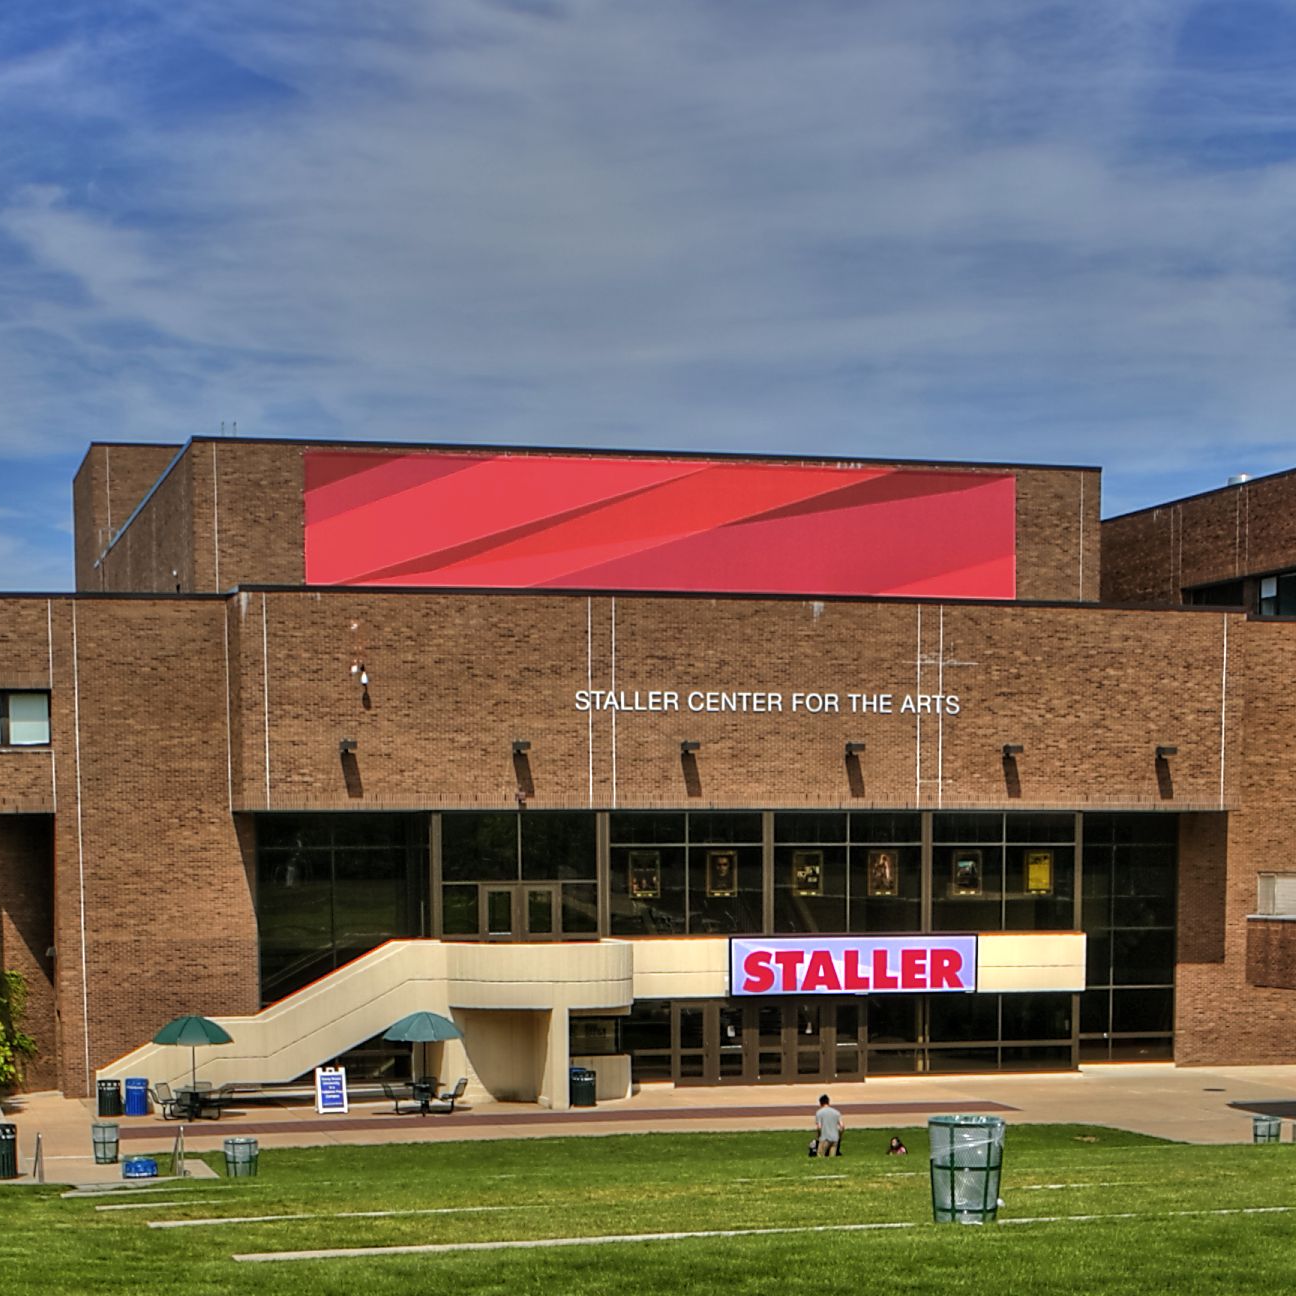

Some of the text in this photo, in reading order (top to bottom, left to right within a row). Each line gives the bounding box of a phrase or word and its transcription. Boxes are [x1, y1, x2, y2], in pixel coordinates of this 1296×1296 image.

[575, 690, 961, 715] STALLER CENTER FOR THE ARTS
[742, 948, 965, 993] STALLER
